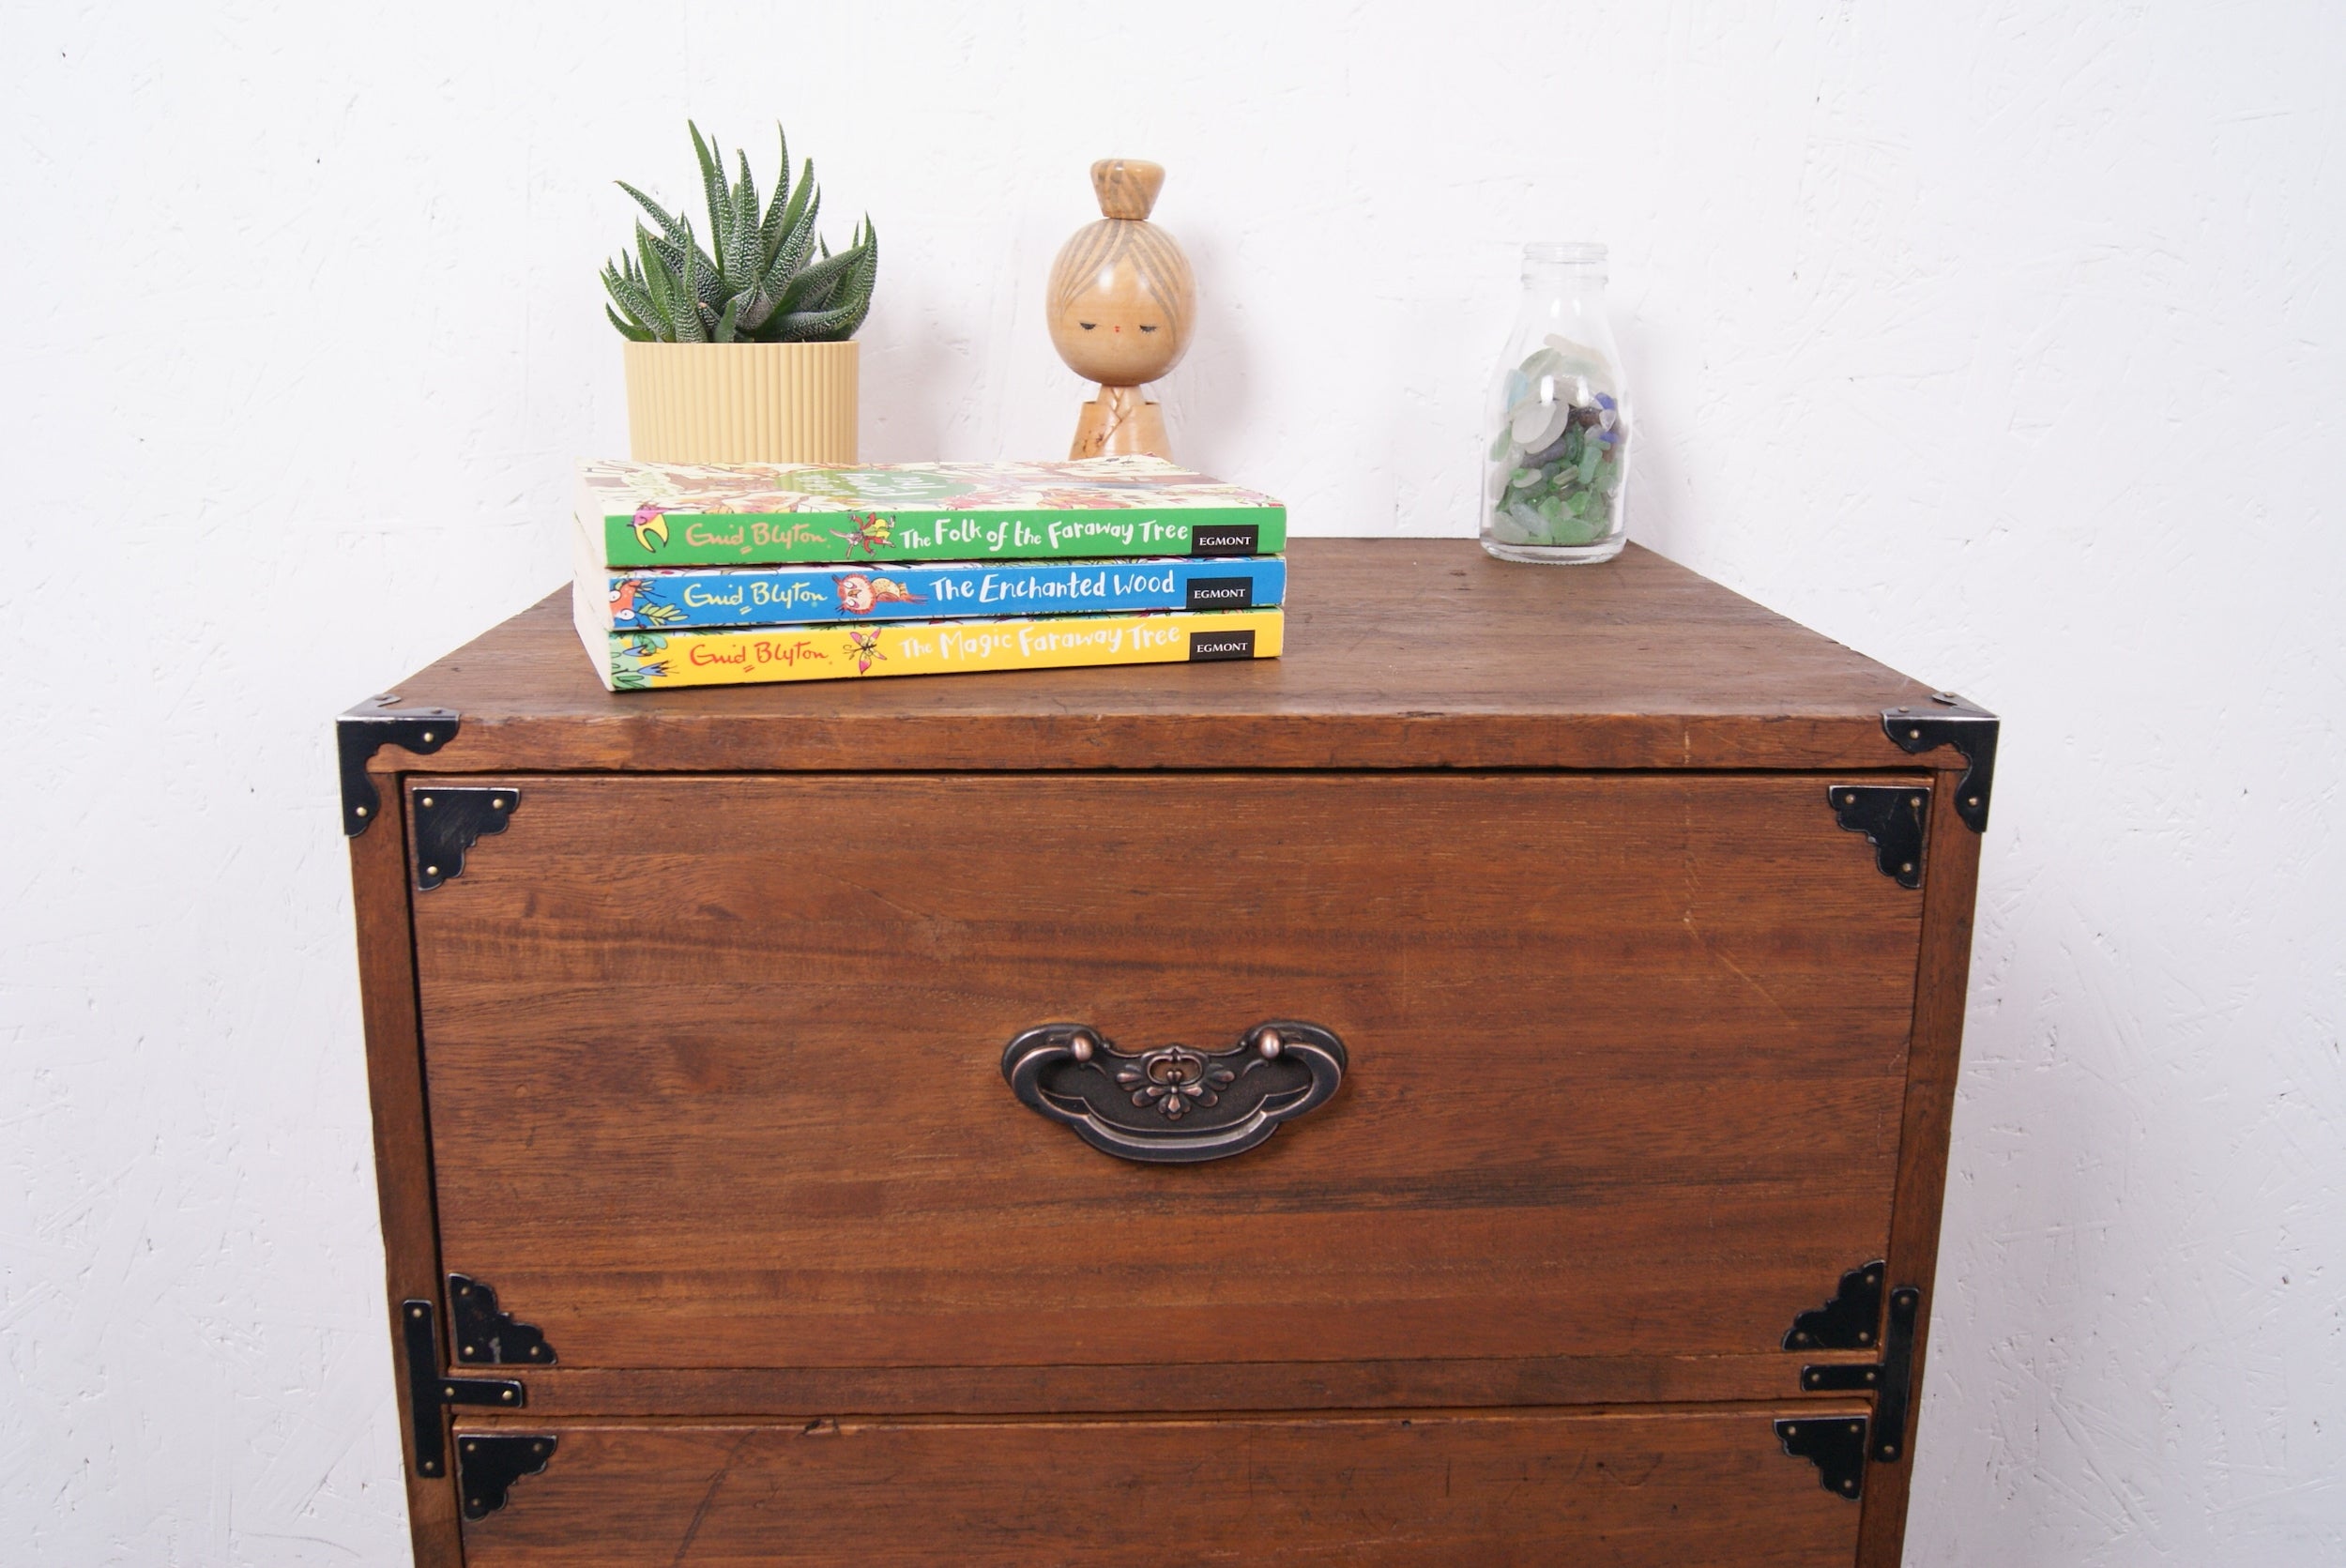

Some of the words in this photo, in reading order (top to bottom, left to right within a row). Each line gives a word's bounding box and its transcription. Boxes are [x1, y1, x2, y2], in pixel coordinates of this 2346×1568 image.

[685, 523, 744, 547] Enid
[751, 522, 827, 550] Blyton
[899, 528, 932, 549] The
[935, 518, 983, 545] Folk
[986, 522, 1009, 552] of
[1014, 521, 1042, 547] the
[1047, 521, 1134, 549] Faraway
[1138, 519, 1189, 543] Tree
[1199, 536, 1252, 546] EGMONT
[684, 583, 743, 607] Enid
[751, 582, 828, 609] Blyton
[929, 577, 975, 601] The
[979, 571, 1106, 603] Enchanted
[1113, 570, 1176, 596] Wood
[1194, 589, 1245, 600] EGMONT
[690, 644, 746, 666] Enid
[754, 641, 829, 666] Blyton
[899, 637, 933, 659] The
[939, 629, 1013, 661] Magic
[1018, 626, 1123, 657] Faraway
[1126, 623, 1181, 650] Tree
[1196, 643, 1248, 653] EGMONT
